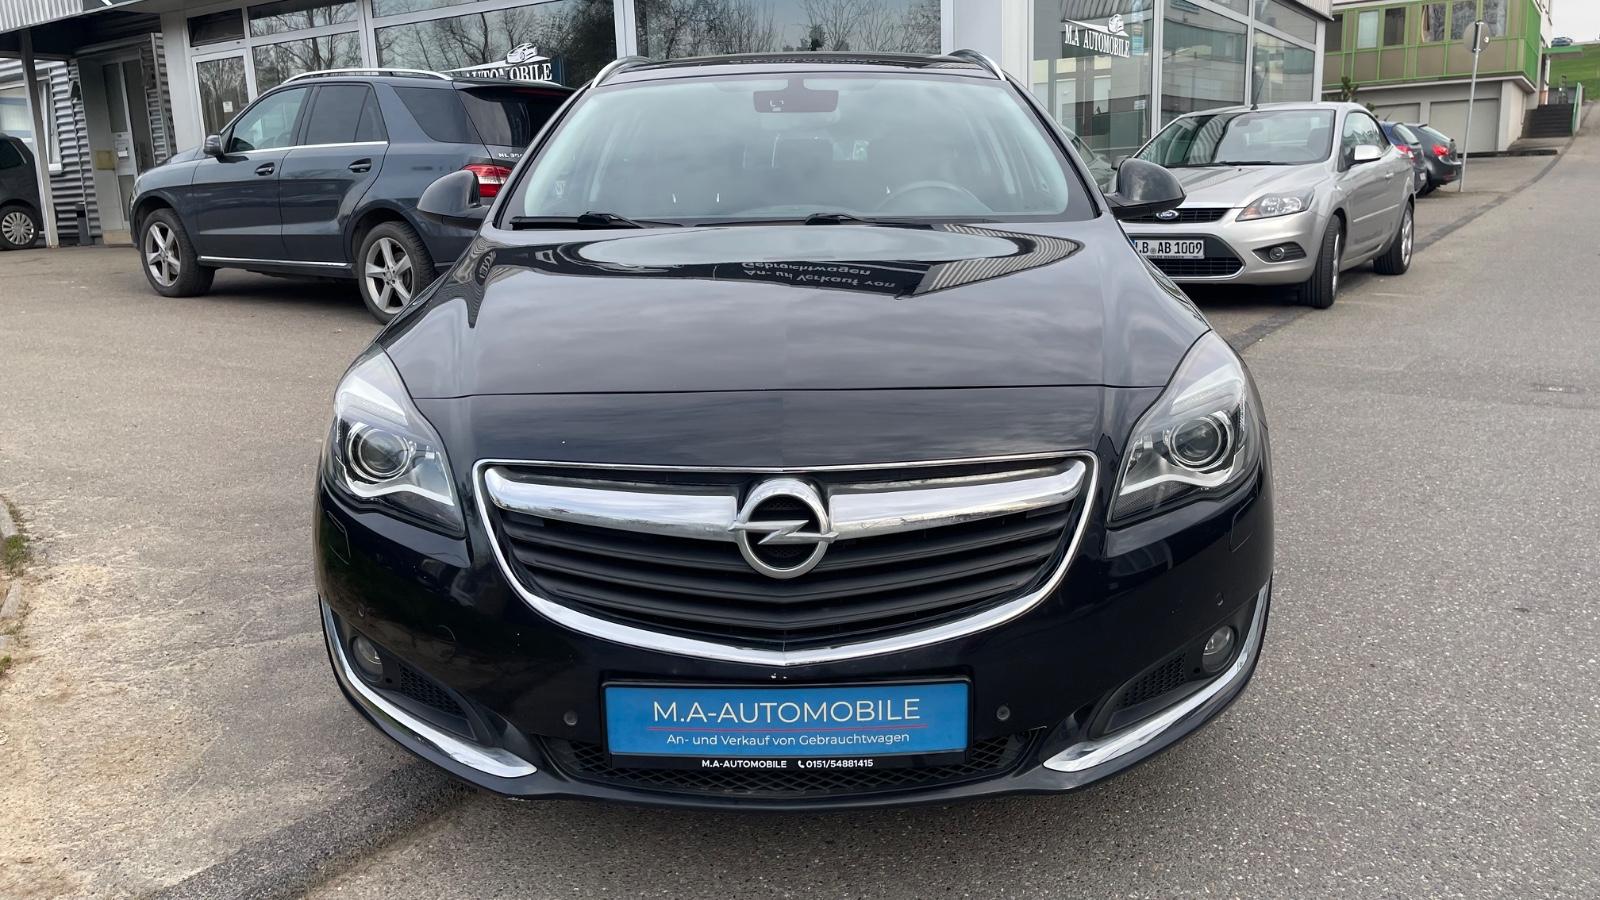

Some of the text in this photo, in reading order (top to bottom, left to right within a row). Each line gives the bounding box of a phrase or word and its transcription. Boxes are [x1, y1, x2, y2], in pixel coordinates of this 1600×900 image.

[1065, 24, 1079, 46] M.A
[1083, 29, 1130, 58] AUTOMOBILE
[1157, 241, 1172, 254] AB
[1174, 241, 1203, 254] 1009
[653, 698, 920, 723] M.A-AUTOMOBILE
[667, 733, 910, 746] An- und Verkauf von Gebrauchtwagen
[701, 759, 874, 769] M.A-AUTOMOBILE 0151/54881415
